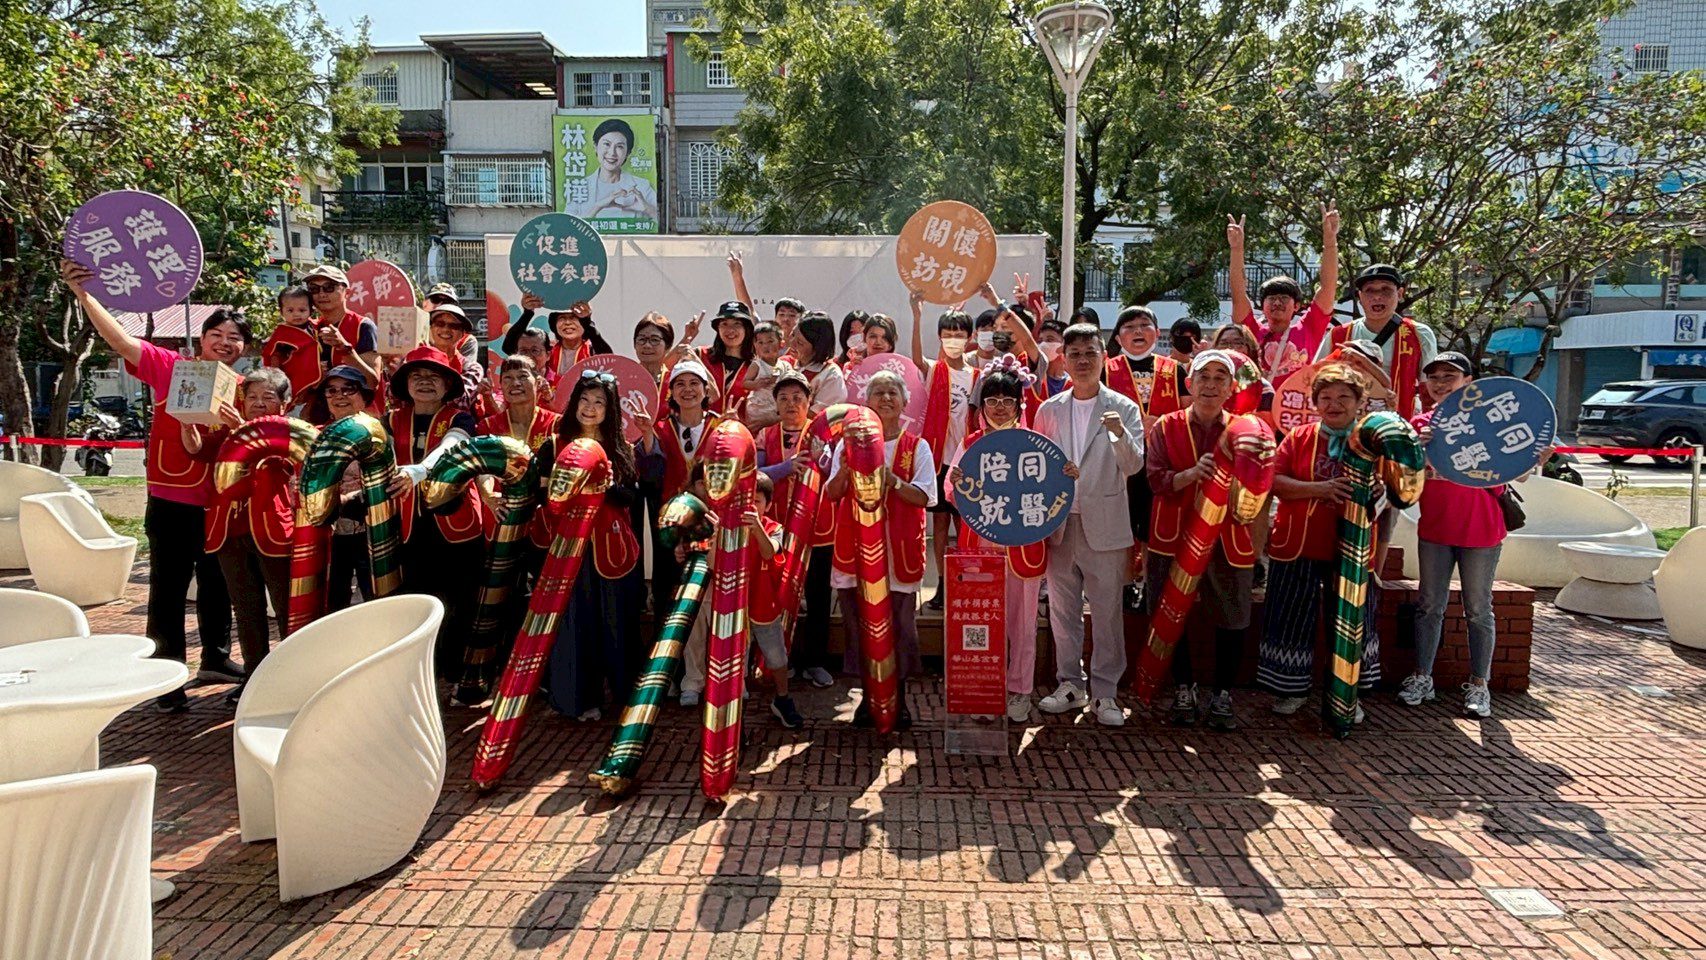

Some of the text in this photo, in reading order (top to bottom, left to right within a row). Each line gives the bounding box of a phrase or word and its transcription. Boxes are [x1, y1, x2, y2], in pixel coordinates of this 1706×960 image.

[562, 124, 588, 204] 林岱樺
[124, 208, 187, 281] 護理
[535, 235, 581, 257] 促進
[922, 215, 979, 258] 關懷
[78, 226, 142, 297] 服務
[516, 262, 601, 285] 社會參與
[911, 252, 967, 294] 訪視
[1437, 410, 1492, 471] 就醫
[1481, 390, 1536, 454] 陪同
[980, 452, 1047, 482] 陪同
[978, 493, 1048, 527] 就醫
